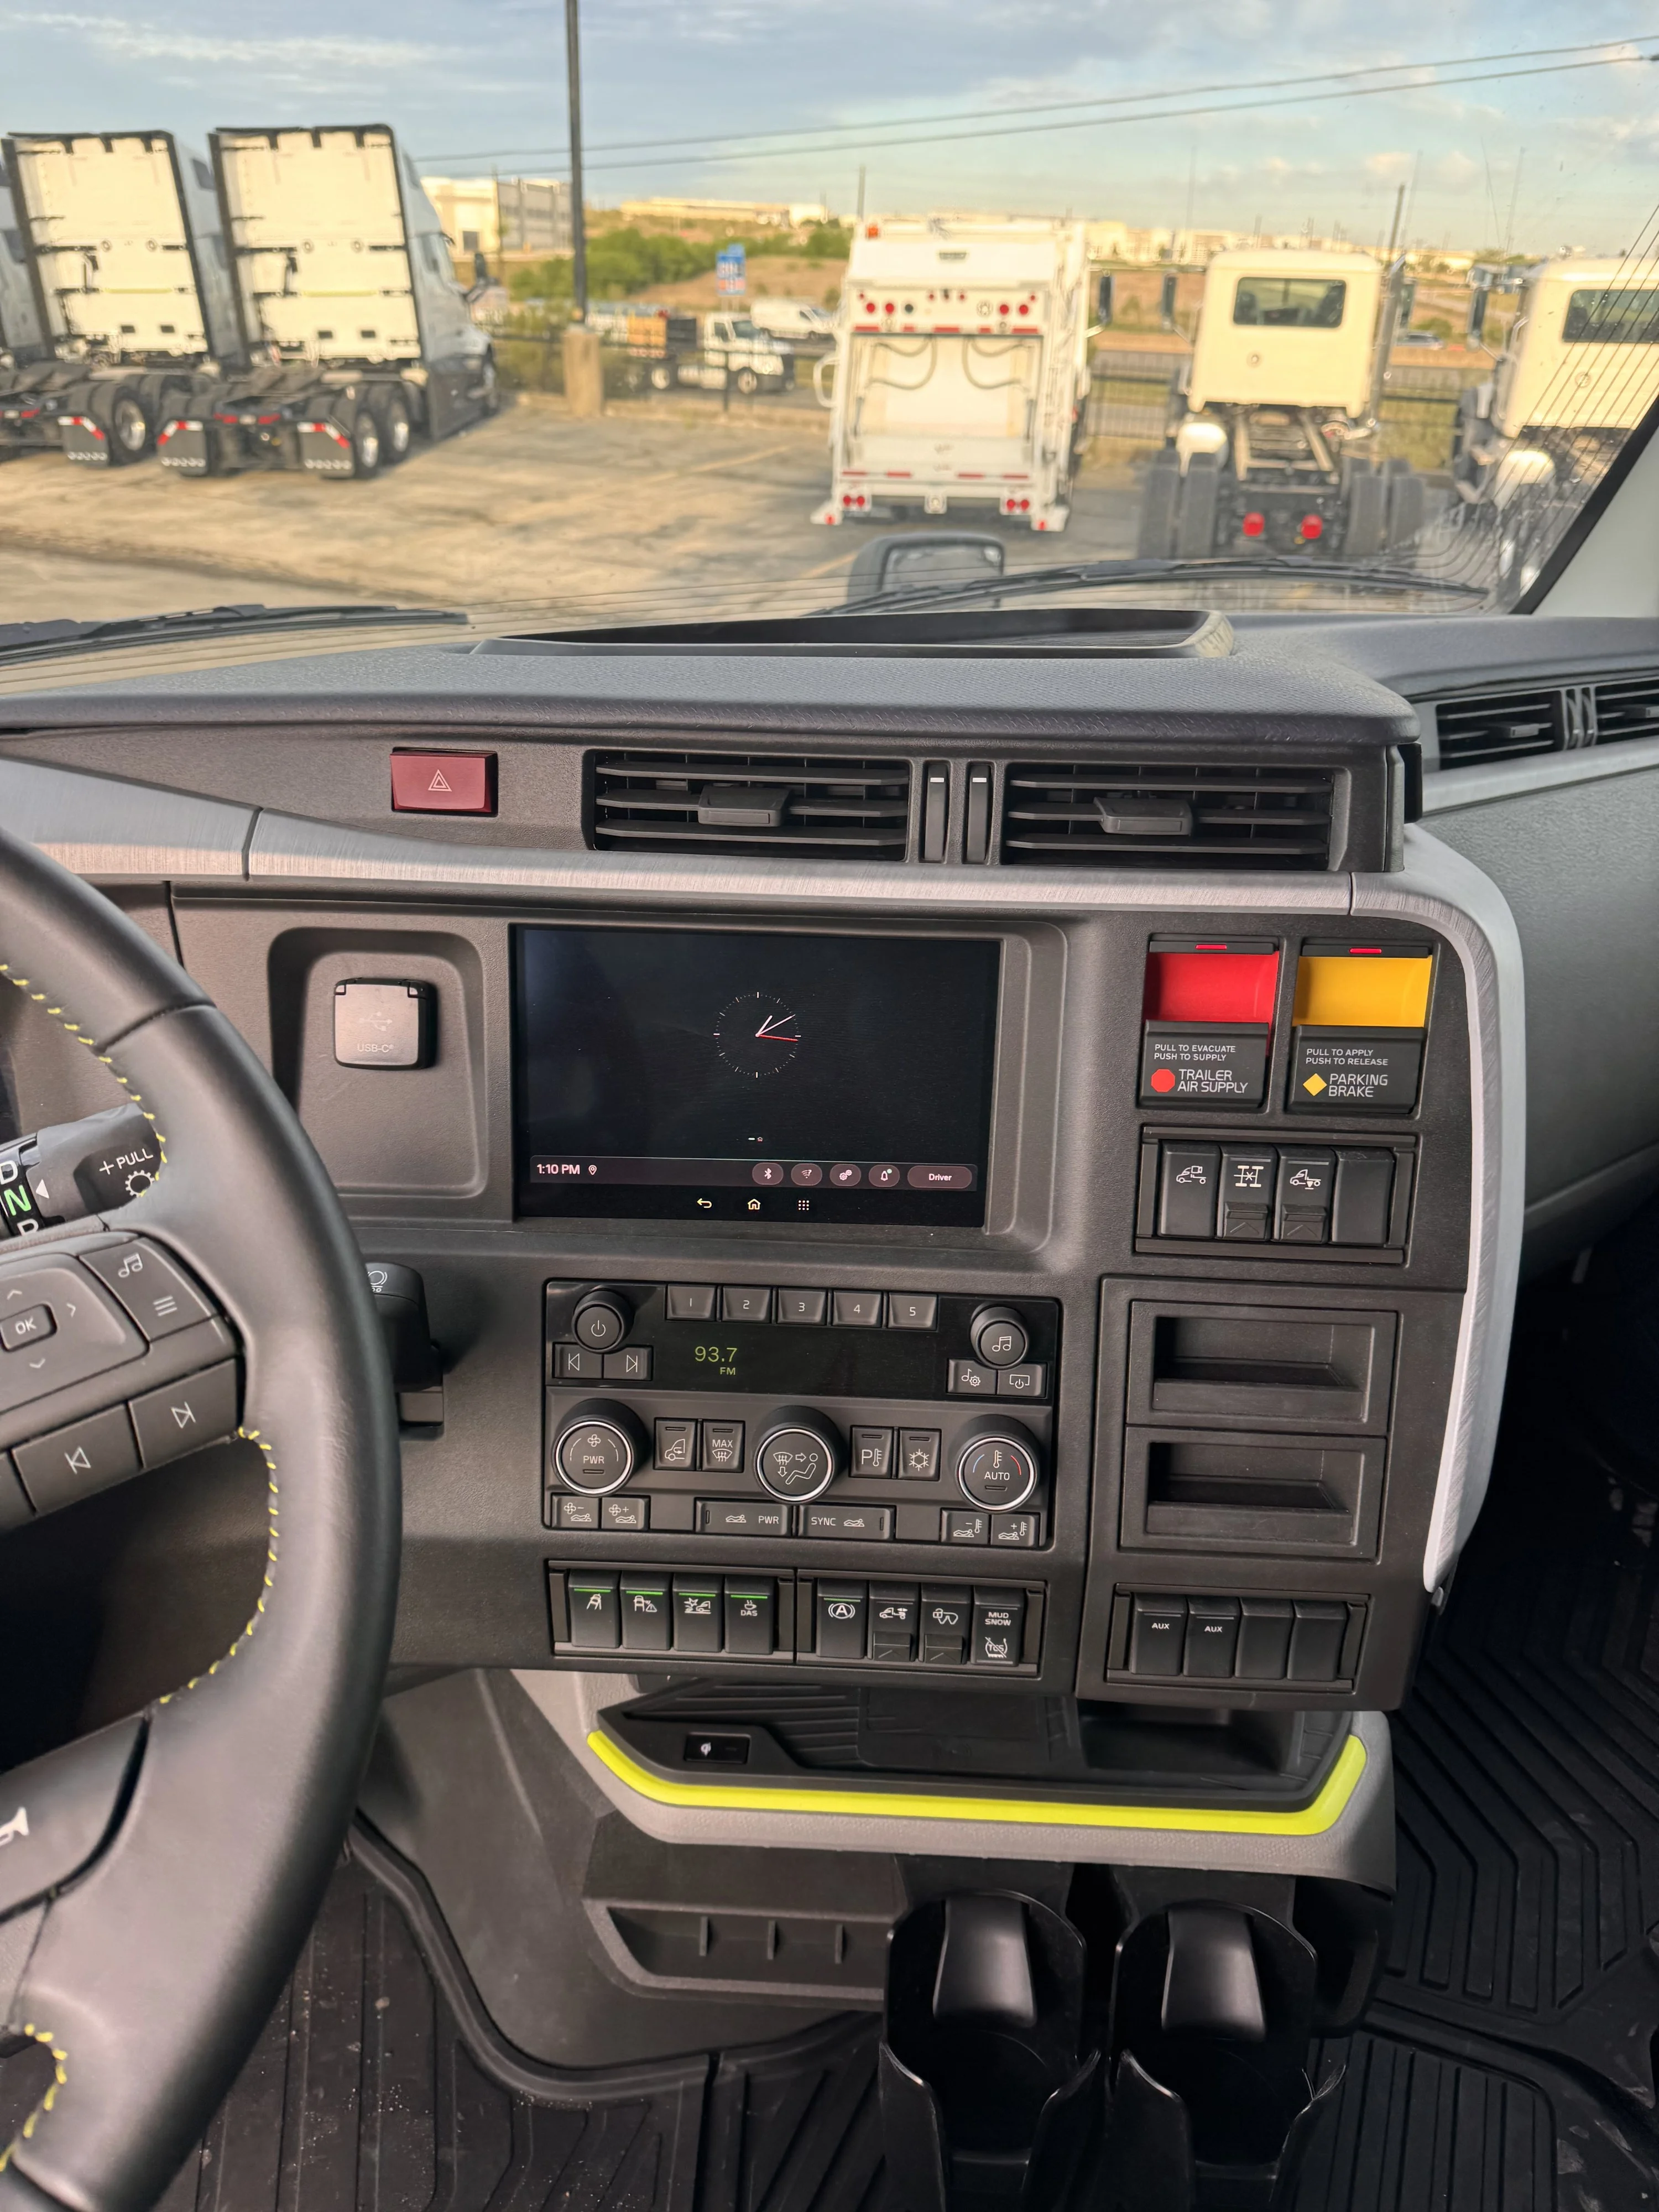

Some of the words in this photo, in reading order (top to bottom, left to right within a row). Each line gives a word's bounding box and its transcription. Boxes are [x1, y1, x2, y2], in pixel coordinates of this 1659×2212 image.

[1178, 1069, 1232, 1081] TRAILER
[1329, 1073, 1388, 1086] PARKING
[1177, 1081, 1198, 1092] AIR
[1201, 1082, 1248, 1093] SUPPLY
[1328, 1086, 1374, 1097] BRAKE
[116, 1148, 154, 1170] PULL
[0, 1160, 18, 1185] D
[537, 1164, 559, 1174] 1:10
[561, 1165, 580, 1175] PM
[4, 1185, 32, 1216] N
[743, 1300, 750, 1310] 2
[799, 1302, 805, 1312] 3
[853, 1305, 860, 1313] 4
[909, 1307, 916, 1316] 5
[15, 1318, 36, 1334] OK
[695, 1347, 738, 1363] 93.7
[720, 1367, 736, 1375] FM
[583, 1455, 604, 1464] PWR
[984, 1472, 1010, 1480] AUTO
[758, 1516, 779, 1525] PWR
[811, 1517, 836, 1526] SYNC
